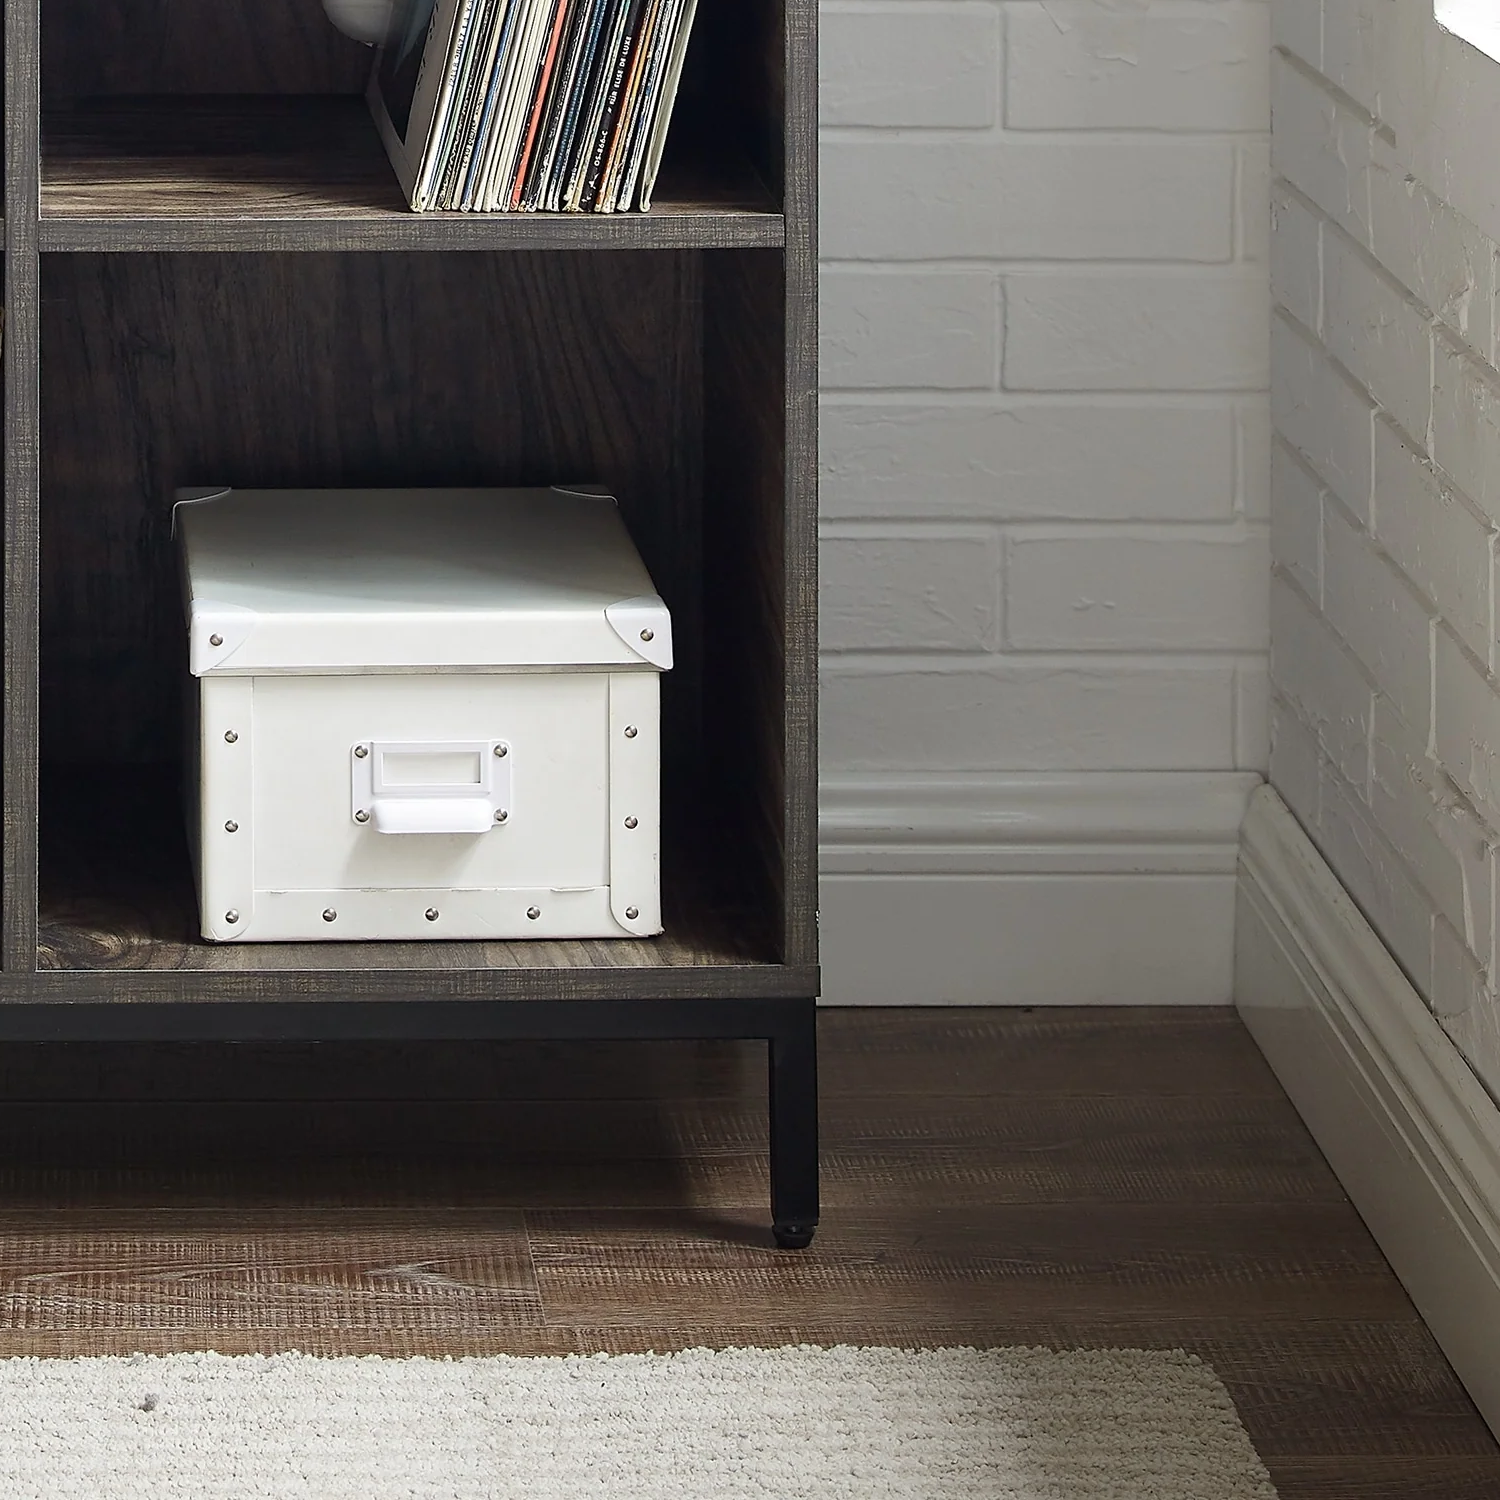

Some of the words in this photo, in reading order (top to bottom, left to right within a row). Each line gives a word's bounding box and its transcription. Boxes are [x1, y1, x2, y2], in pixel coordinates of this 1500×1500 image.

[622, 35, 633, 56] LUXE
[620, 55, 627, 68] DE
[613, 68, 625, 89] ELISE
[593, 129, 609, 167] OS-866-C
